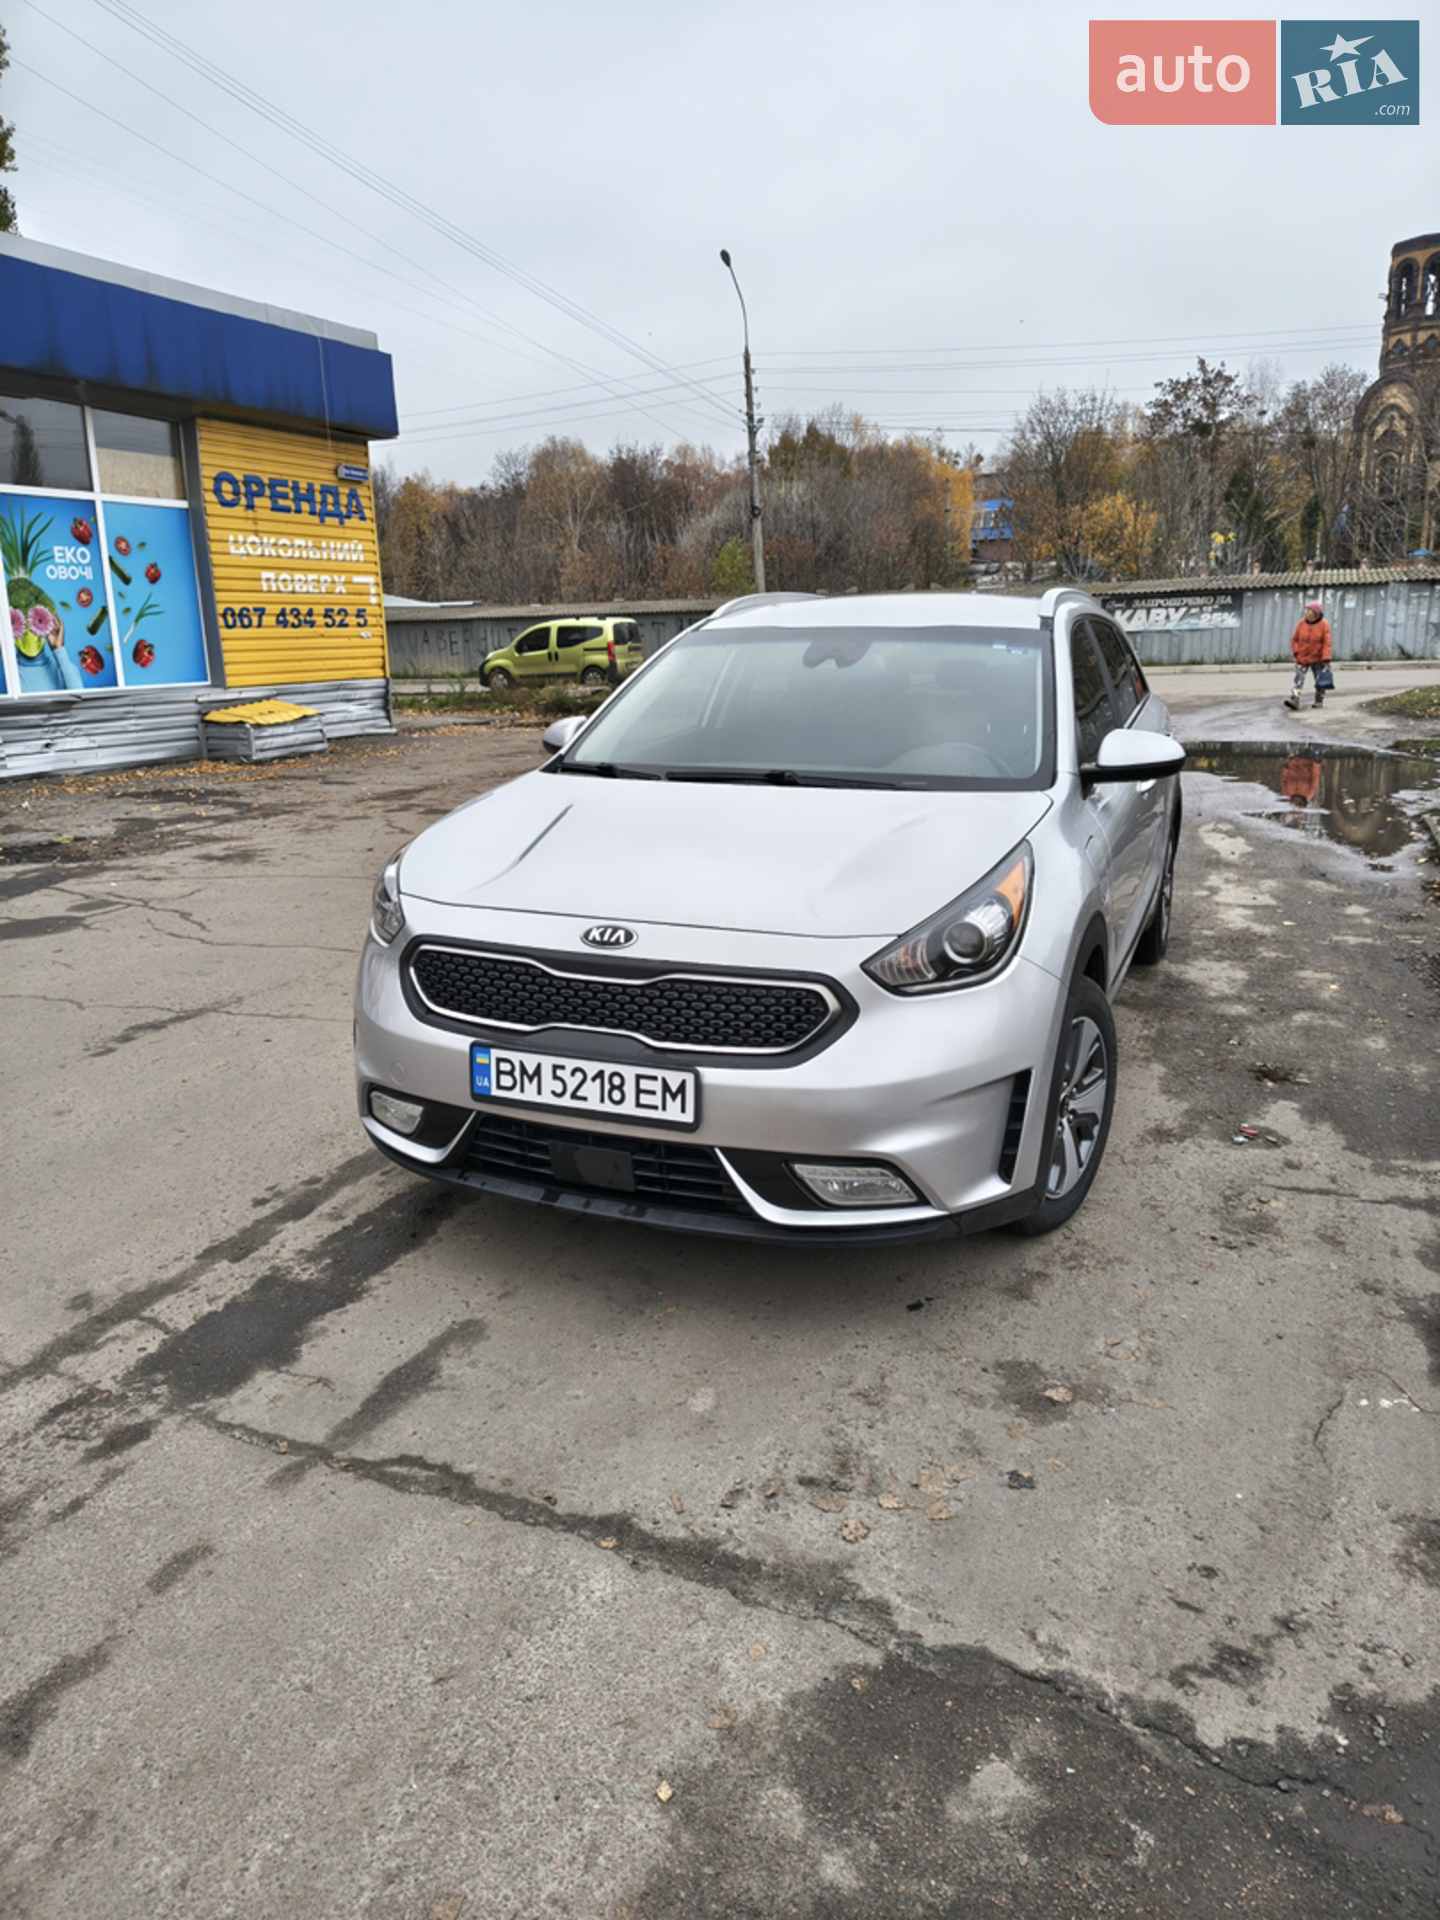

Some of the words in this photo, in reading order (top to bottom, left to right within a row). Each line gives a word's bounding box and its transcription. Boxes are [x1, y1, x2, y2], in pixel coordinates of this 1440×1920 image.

[213, 471, 367, 526] ОРЕНДА
[53, 545, 91, 565] ЕКО
[228, 534, 364, 562] ЦОКОЛЬНИЙ
[46, 565, 93, 580] ОВОЧІ
[260, 571, 348, 594] ПОВЕРХ
[221, 606, 266, 629] 067
[275, 606, 316, 629] 434
[1114, 607, 1188, 630] КАВУ
[588, 927, 625, 943] KIA
[476, 1075, 490, 1088] UA
[496, 1057, 542, 1096] BM
[551, 1064, 626, 1106] 5218
[634, 1073, 687, 1114] EM
